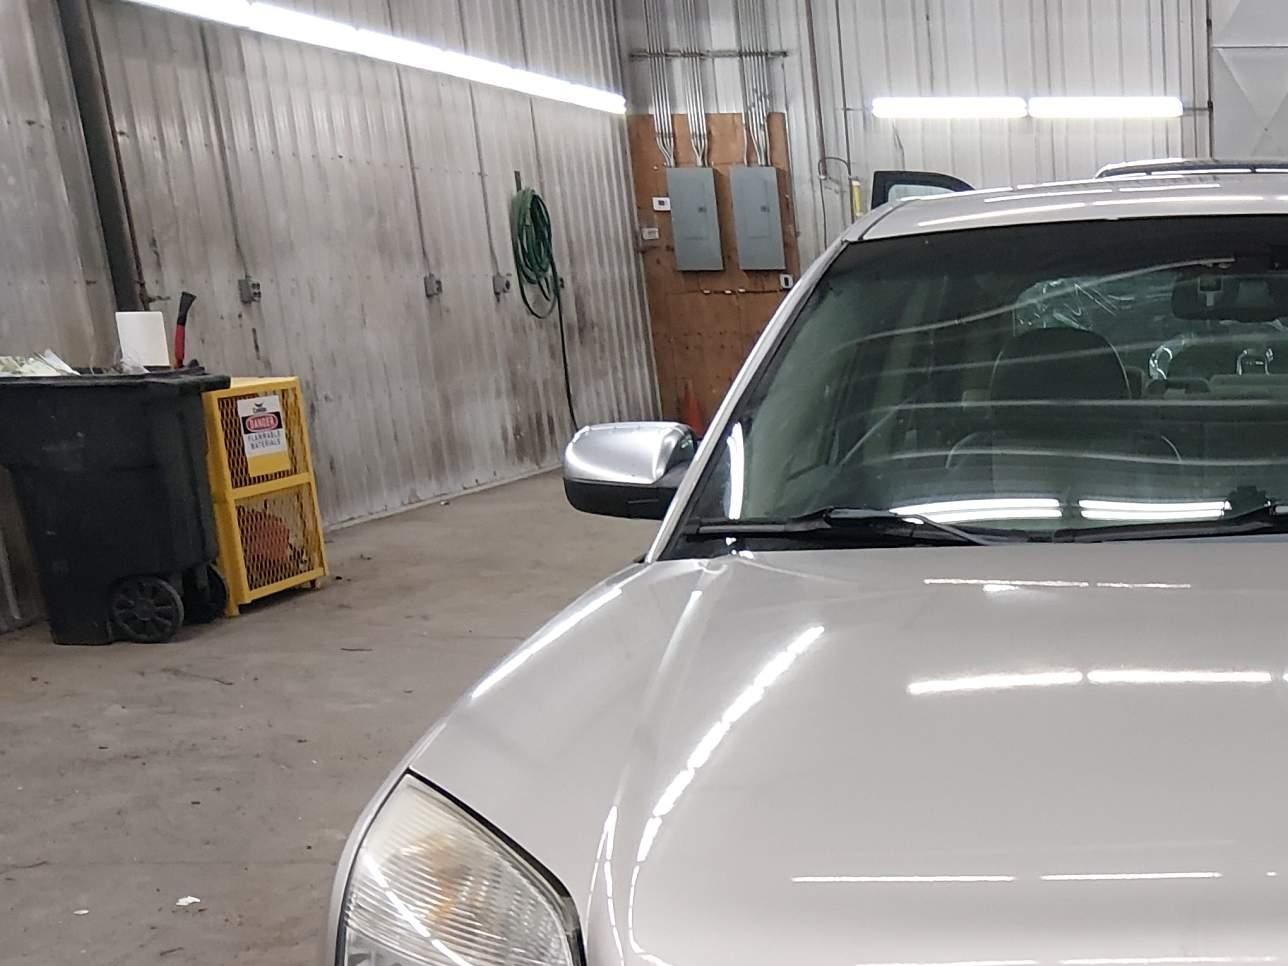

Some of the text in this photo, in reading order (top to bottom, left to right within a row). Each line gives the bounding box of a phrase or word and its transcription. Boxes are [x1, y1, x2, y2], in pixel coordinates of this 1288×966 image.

[249, 416, 276, 429] DANGER
[248, 430, 281, 441] FLAMMABLE
[250, 439, 281, 450] MATERIALS
